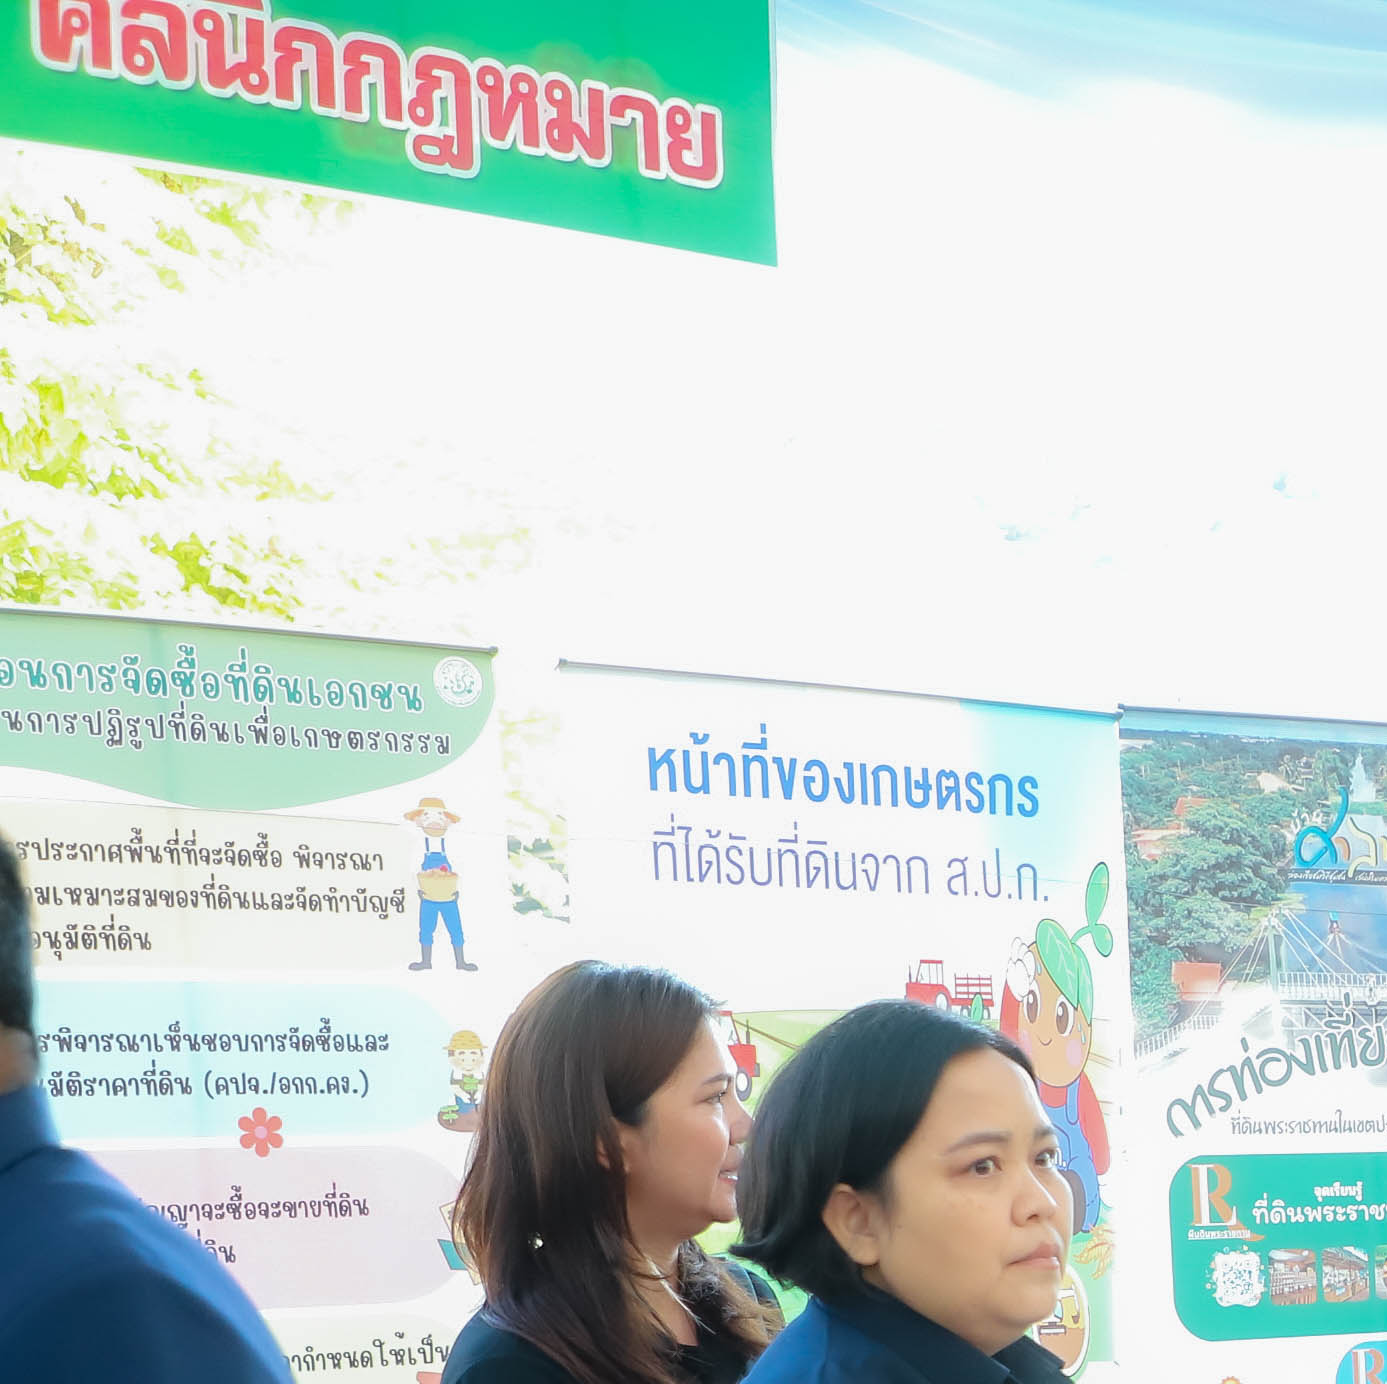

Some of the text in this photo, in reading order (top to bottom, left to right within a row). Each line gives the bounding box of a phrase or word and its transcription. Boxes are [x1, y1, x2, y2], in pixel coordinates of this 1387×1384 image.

[36, 0, 722, 177] คลนกกฎหมาย
[648, 723, 1039, 817] หน้าที่ของเกษตรกร
[293, 844, 384, 871] พิจารณา
[651, 813, 1049, 902] ที่ได้รับที่ดินจาก ส.ป.ก.
[40, 1059, 193, 1097] มัติราคาที่ดิน
